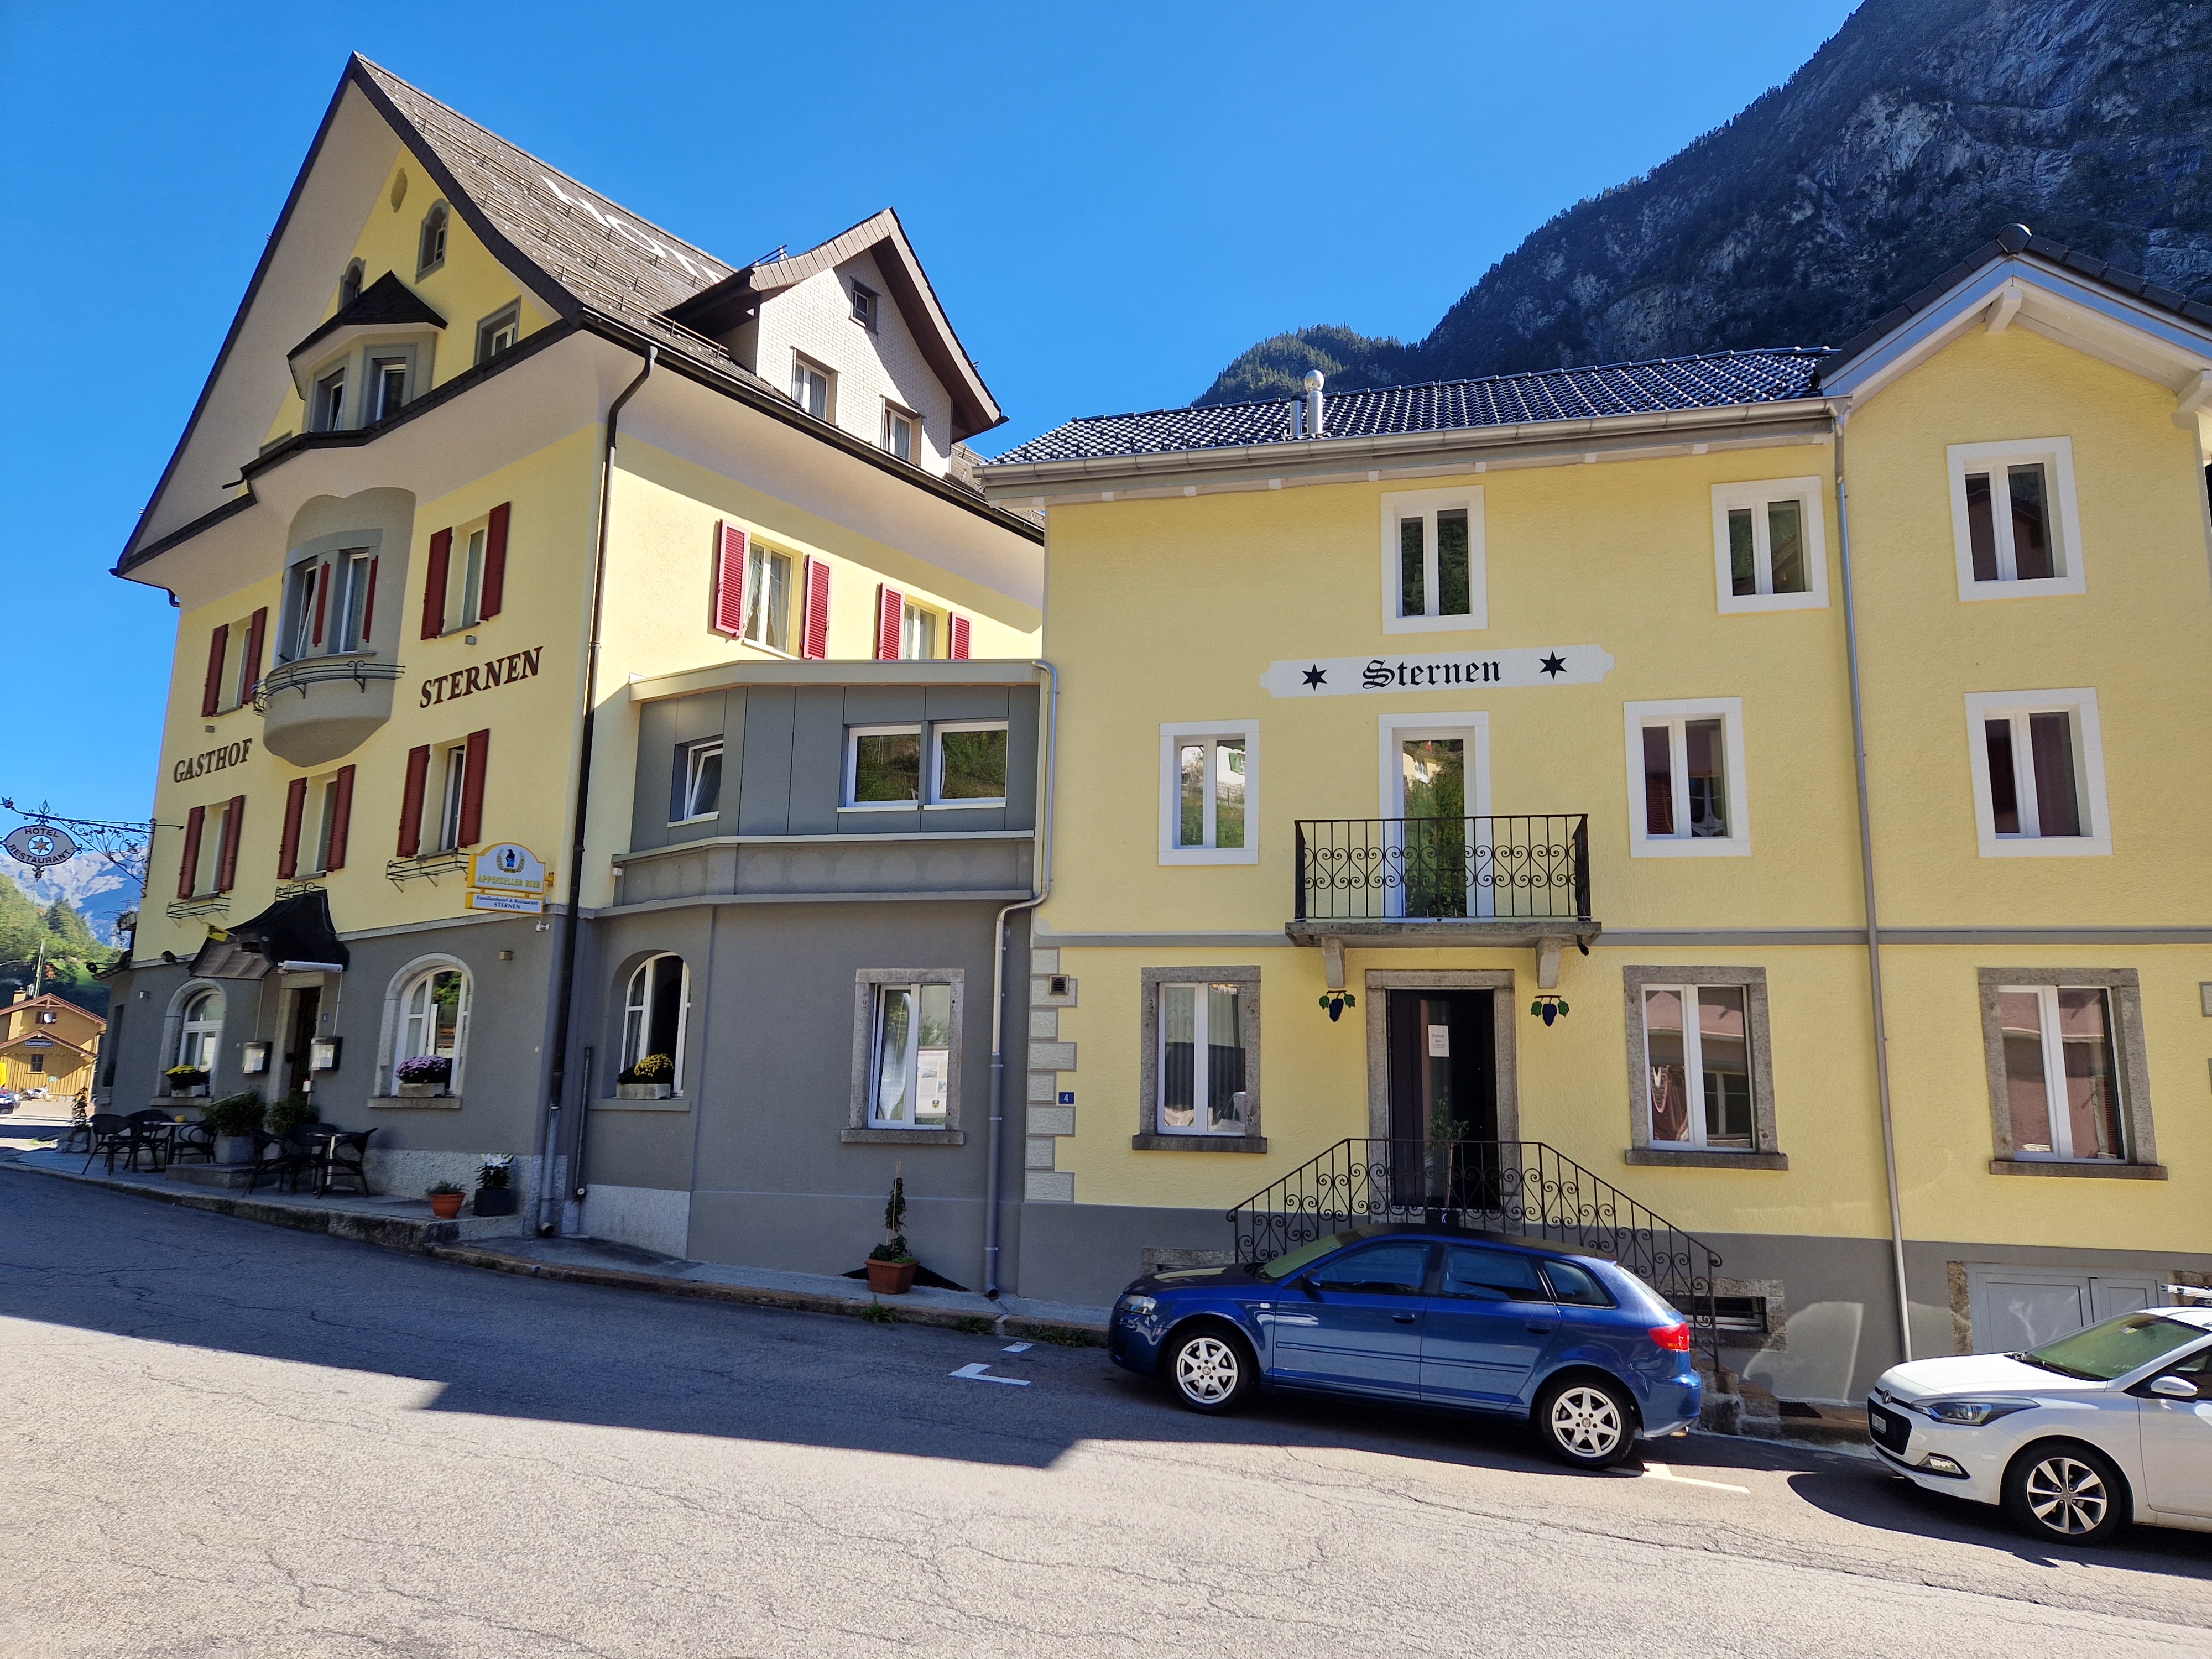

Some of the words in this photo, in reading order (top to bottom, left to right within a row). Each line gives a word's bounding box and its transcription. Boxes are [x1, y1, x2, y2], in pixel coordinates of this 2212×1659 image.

[419, 646, 543, 708] STERNEN
[1361, 659, 1501, 690] Sternen
[173, 738, 252, 783] GASTHOF
[24, 827, 59, 838] HOTEL
[8, 844, 72, 864] RESTAURANT
[477, 875, 523, 887] APPENZELLER
[525, 879, 541, 889] BIER
[1063, 1094, 1068, 1102] 4
